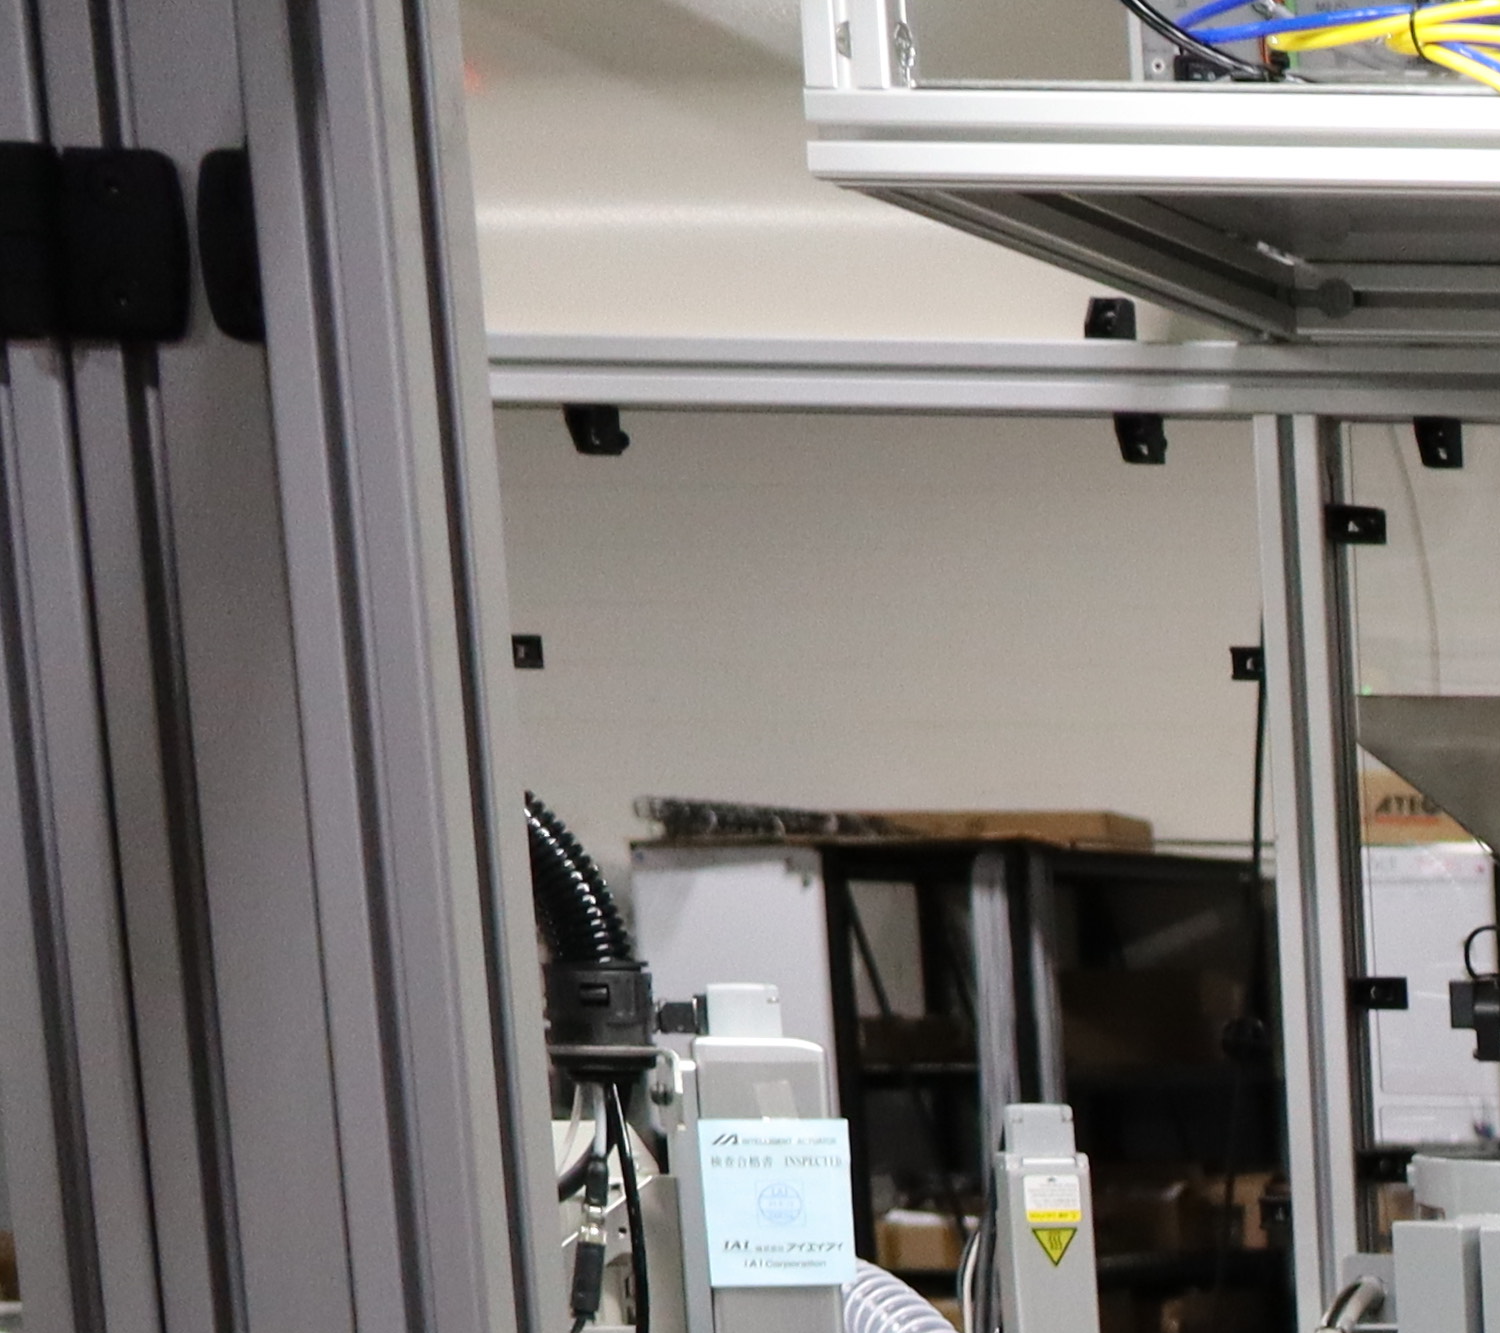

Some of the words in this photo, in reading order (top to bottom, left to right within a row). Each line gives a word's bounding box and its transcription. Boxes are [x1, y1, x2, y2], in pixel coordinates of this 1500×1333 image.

[784, 1155, 842, 1168] INSPECTED
[724, 1240, 750, 1251] IAI
[765, 1259, 828, 1270] Corporation
